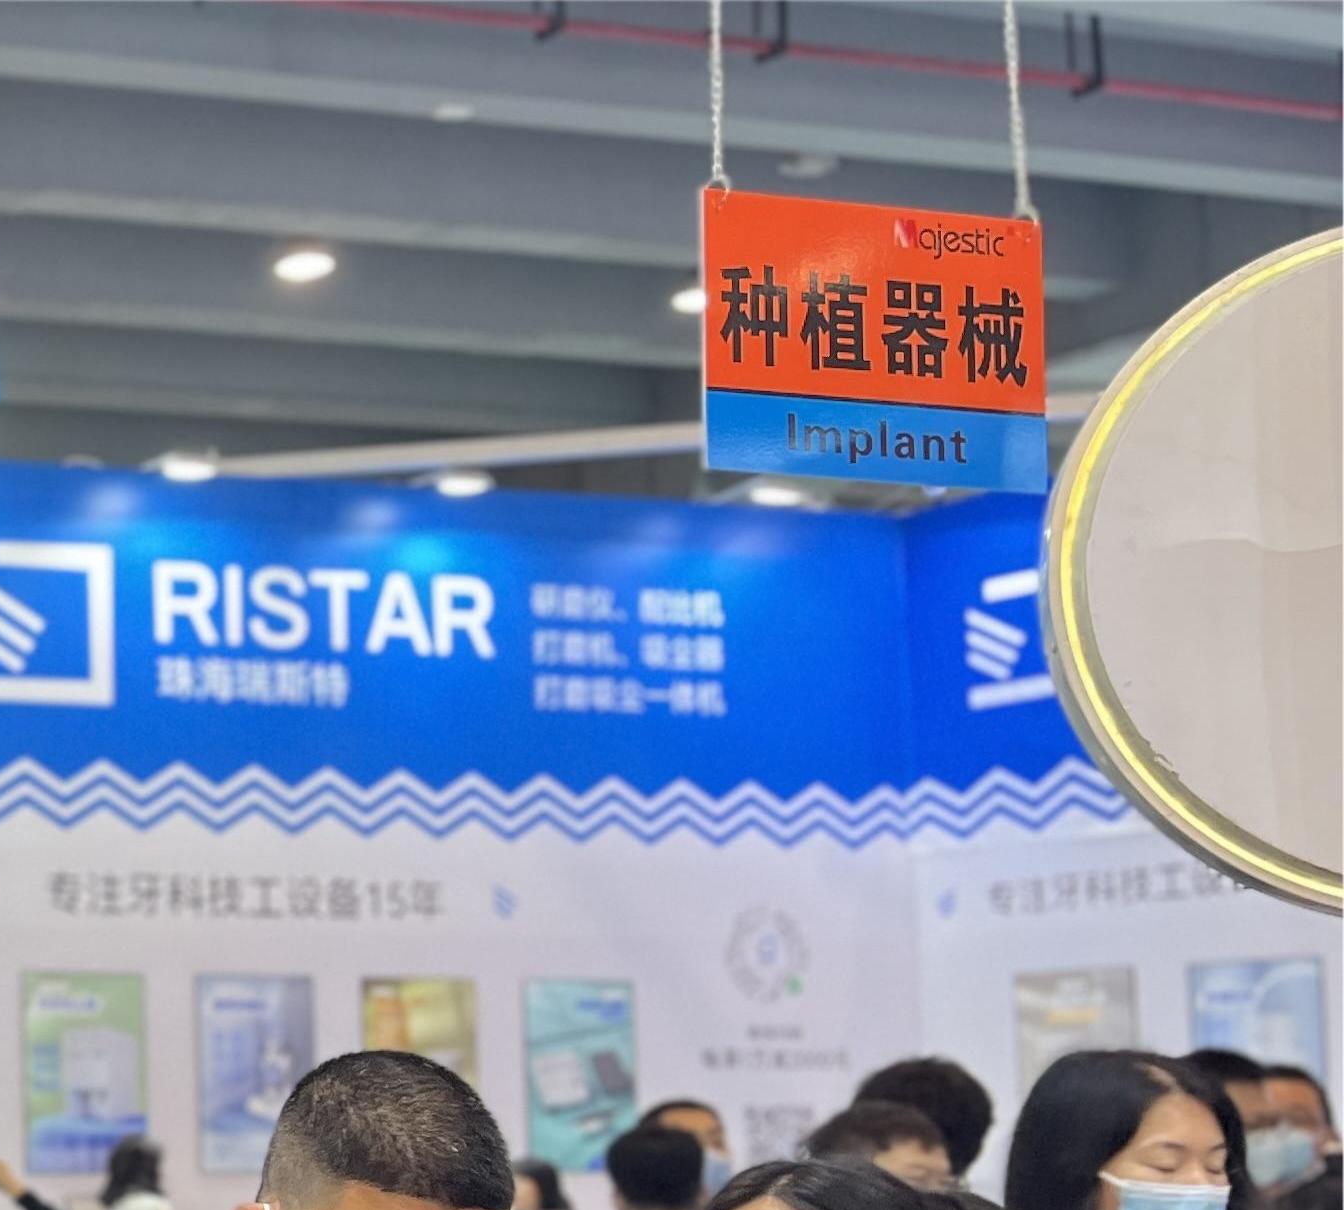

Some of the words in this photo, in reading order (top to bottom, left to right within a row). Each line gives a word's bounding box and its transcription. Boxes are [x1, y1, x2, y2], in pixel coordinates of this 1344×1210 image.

[893, 218, 1005, 260] Majestic
[719, 264, 1028, 388] 种植器械
[787, 413, 968, 464] Implant
[151, 558, 497, 660] RISTAR
[47, 870, 444, 921] 专注牙科技工设备15年
